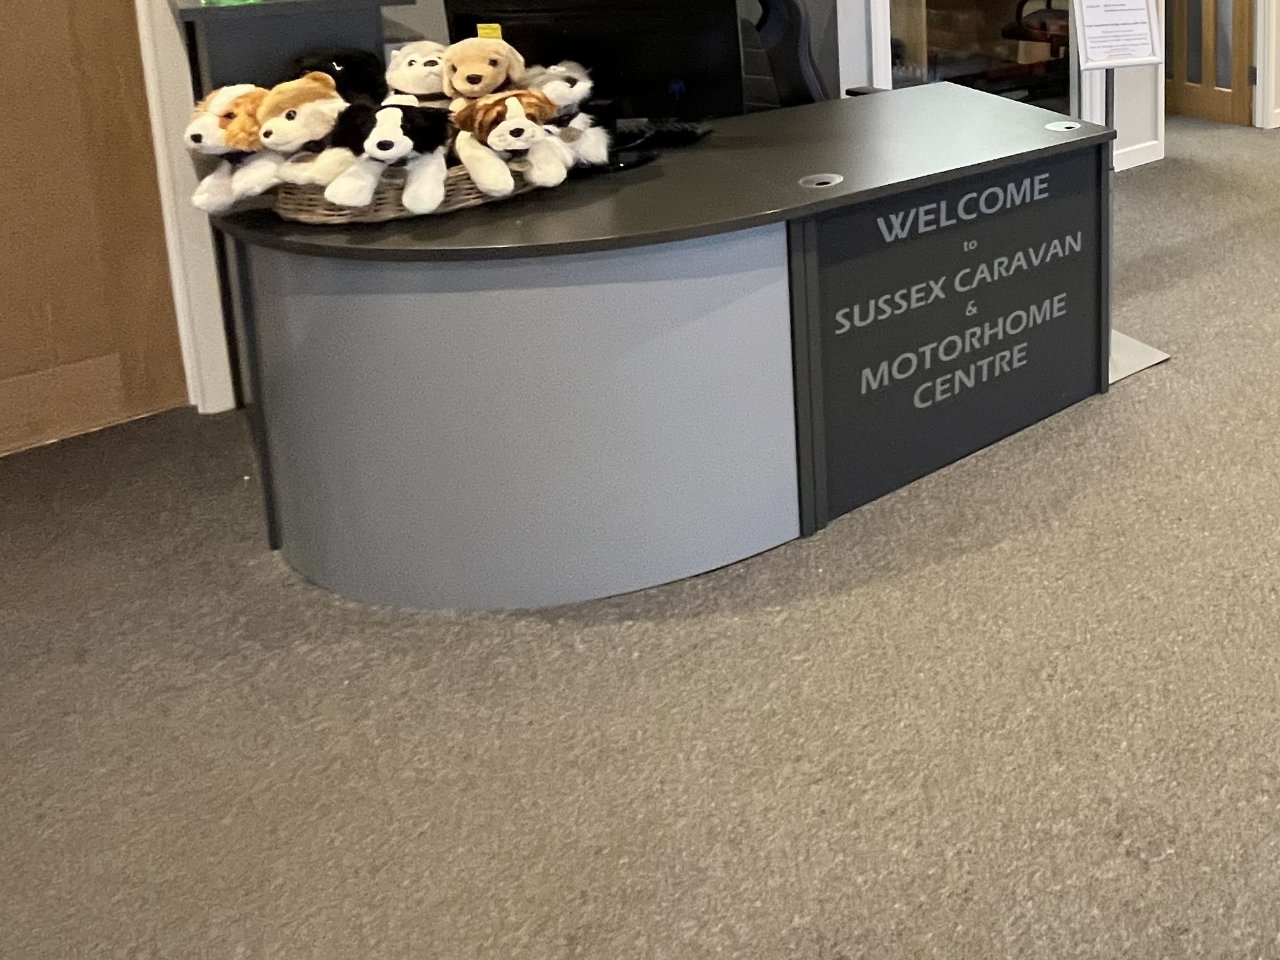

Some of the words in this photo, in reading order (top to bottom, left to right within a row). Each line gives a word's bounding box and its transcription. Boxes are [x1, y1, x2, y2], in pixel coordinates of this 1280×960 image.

[876, 172, 1050, 243] WELCOME
[963, 239, 978, 252] to
[835, 276, 947, 335] SUSSEX
[954, 231, 1083, 293] CARAVAN
[965, 300, 979, 317] &
[860, 293, 1068, 394] MOTORHOME
[913, 342, 1029, 409] CENTRE
